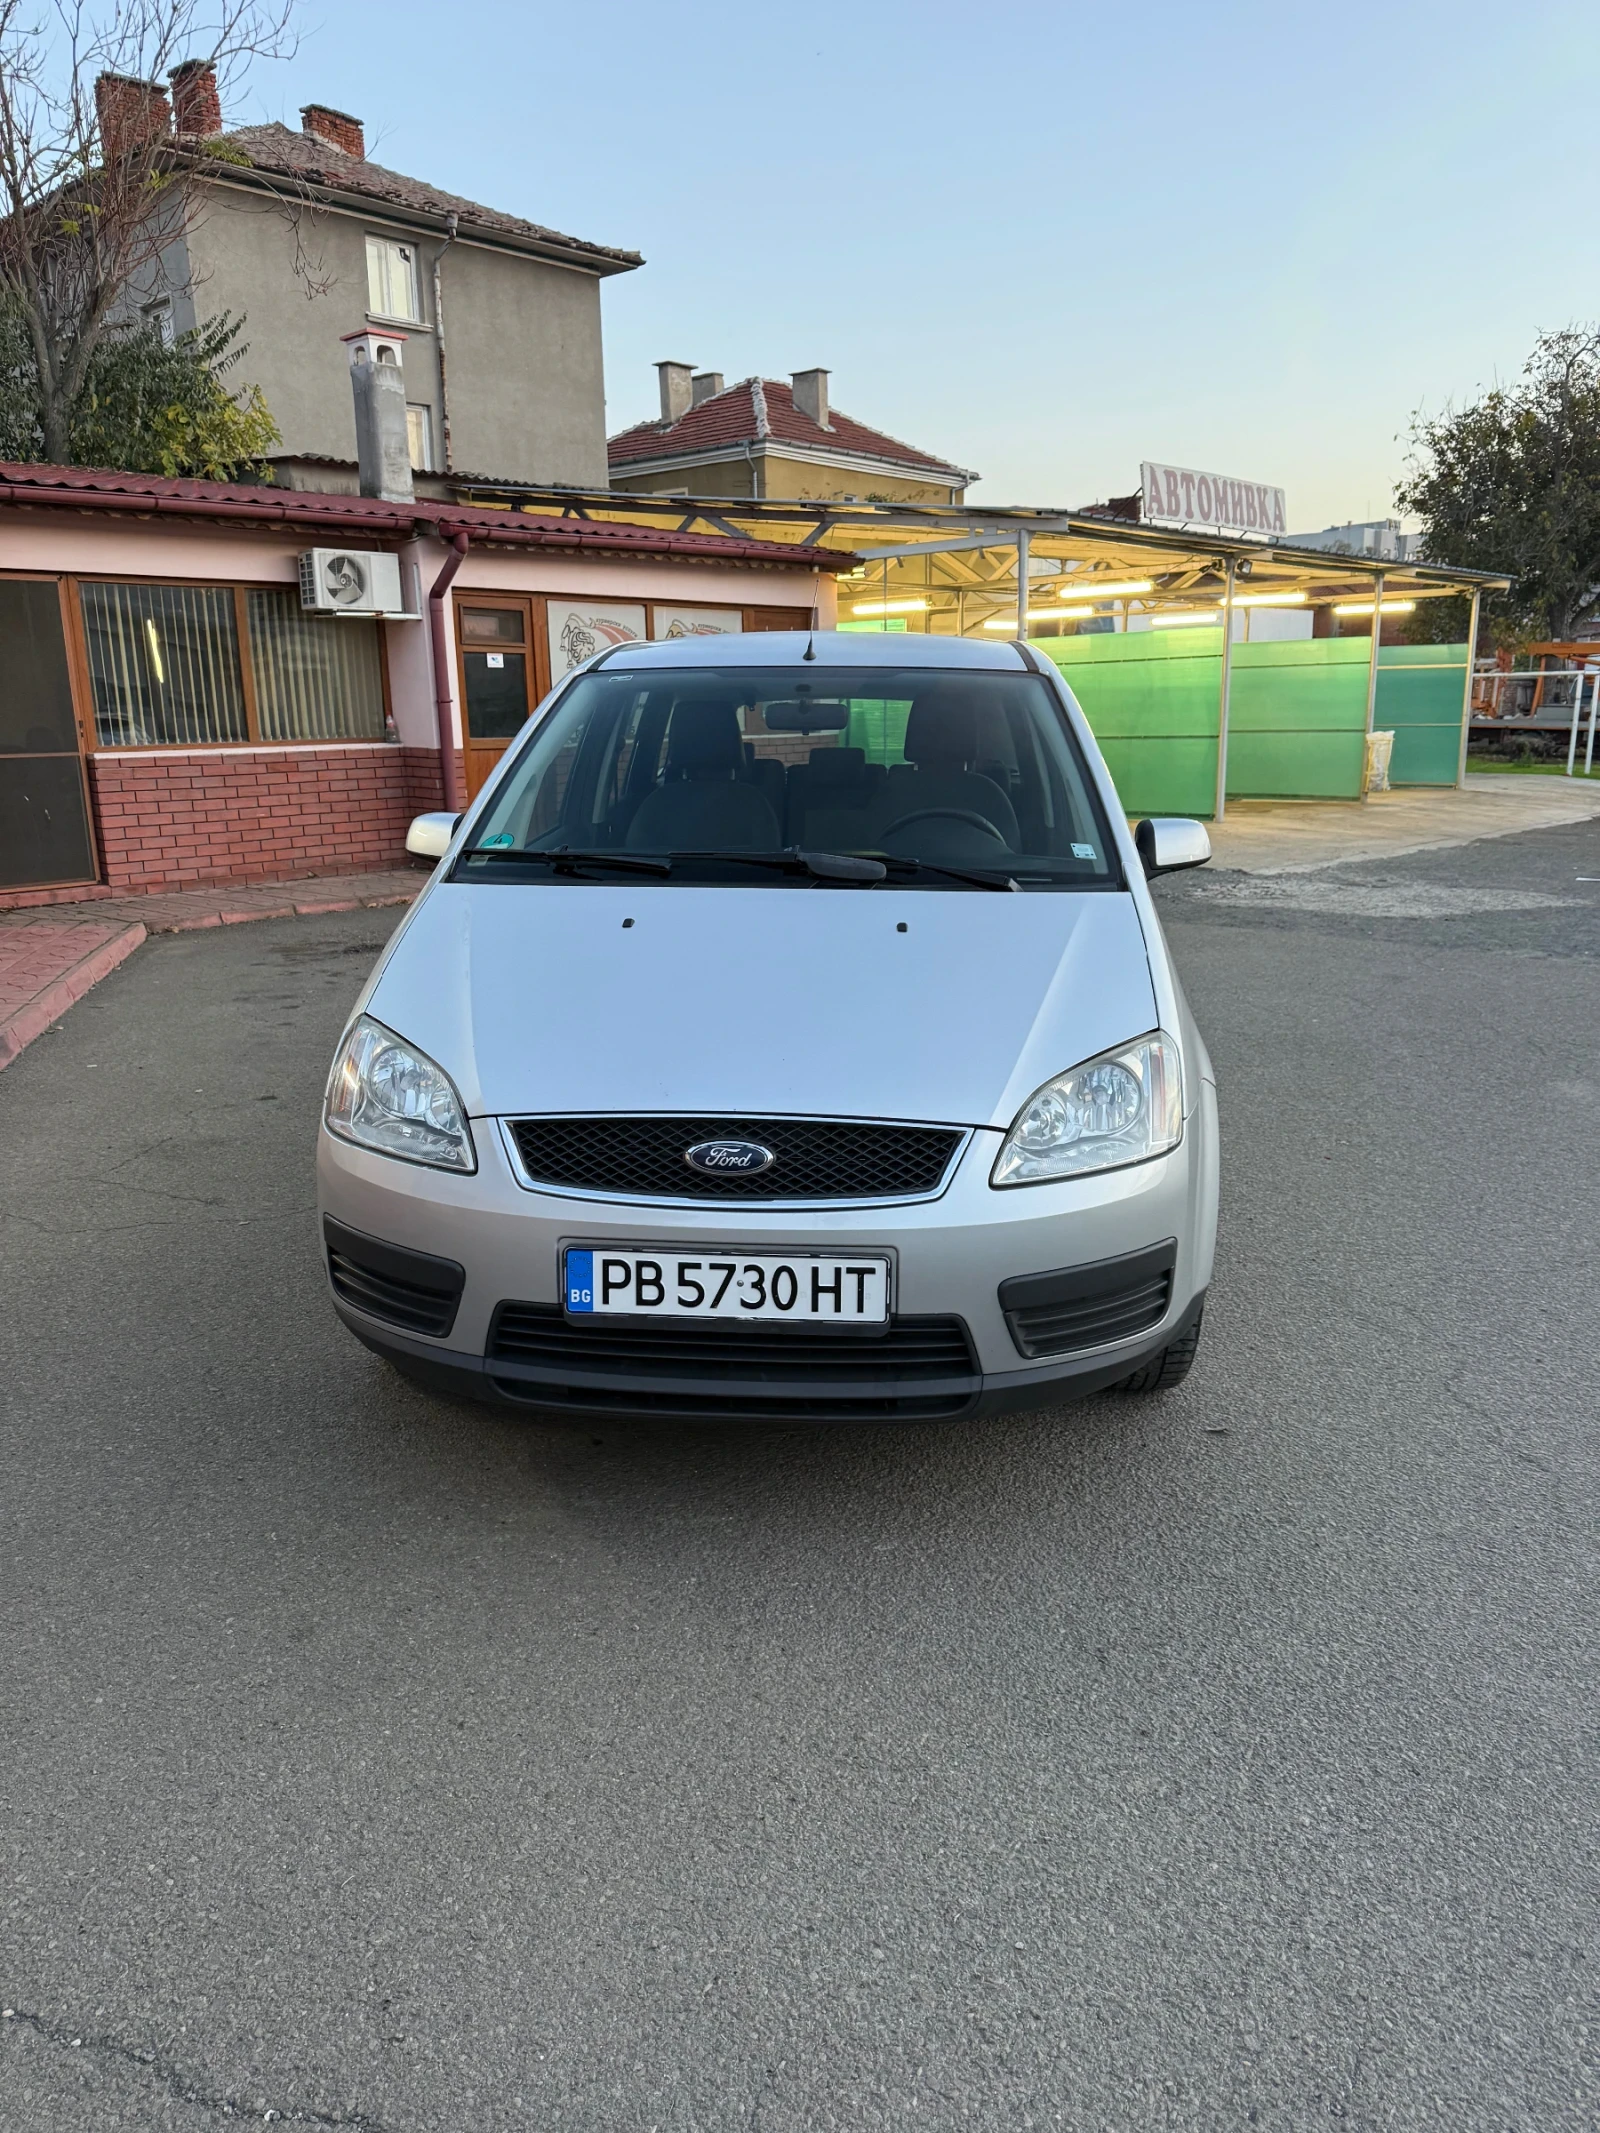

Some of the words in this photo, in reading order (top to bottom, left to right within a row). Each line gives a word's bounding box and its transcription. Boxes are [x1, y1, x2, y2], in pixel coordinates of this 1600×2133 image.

[1147, 466, 1286, 532] АВТОМИВКА
[493, 834, 503, 844] 4
[705, 1147, 753, 1167] Ford
[571, 1289, 591, 1303] BG
[602, 1258, 665, 1307] PB
[677, 1262, 798, 1311] 5730
[811, 1266, 876, 1314] HT
